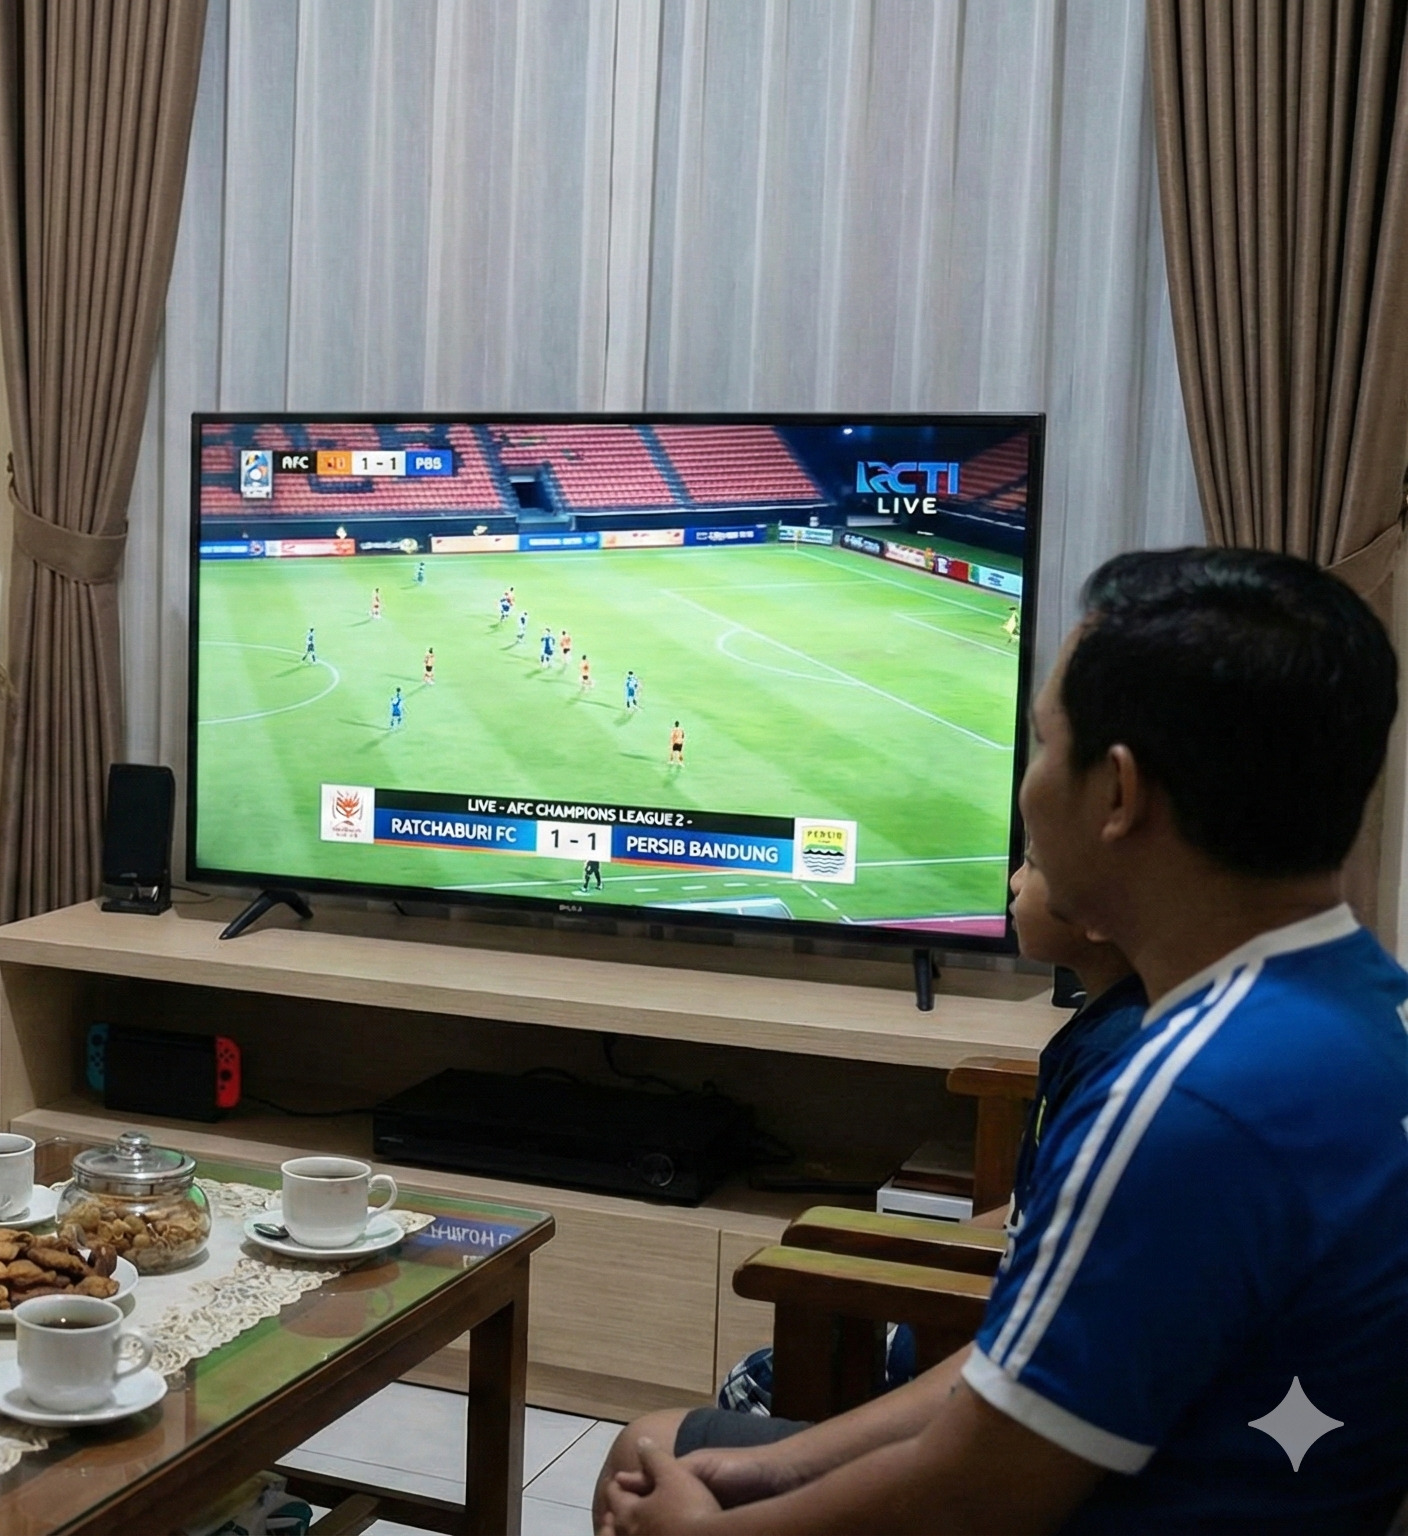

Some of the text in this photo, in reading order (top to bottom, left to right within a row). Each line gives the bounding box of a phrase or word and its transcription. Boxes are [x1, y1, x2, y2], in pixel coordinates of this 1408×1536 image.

[282, 455, 309, 469] AFC
[362, 457, 368, 470] 1
[390, 457, 397, 470] 1
[856, 461, 959, 494] RCTI
[878, 497, 937, 514] LIVE
[468, 798, 496, 813] LIVE
[507, 801, 534, 816] AFC
[536, 803, 616, 822] CHAMPIONS
[619, 811, 673, 826] LEAGUE
[675, 813, 684, 827] 2
[391, 817, 517, 843] RATCHABURI FC
[551, 829, 560, 848] 1
[587, 832, 596, 851] 1
[626, 836, 779, 863] PERSIB BANDUNG
